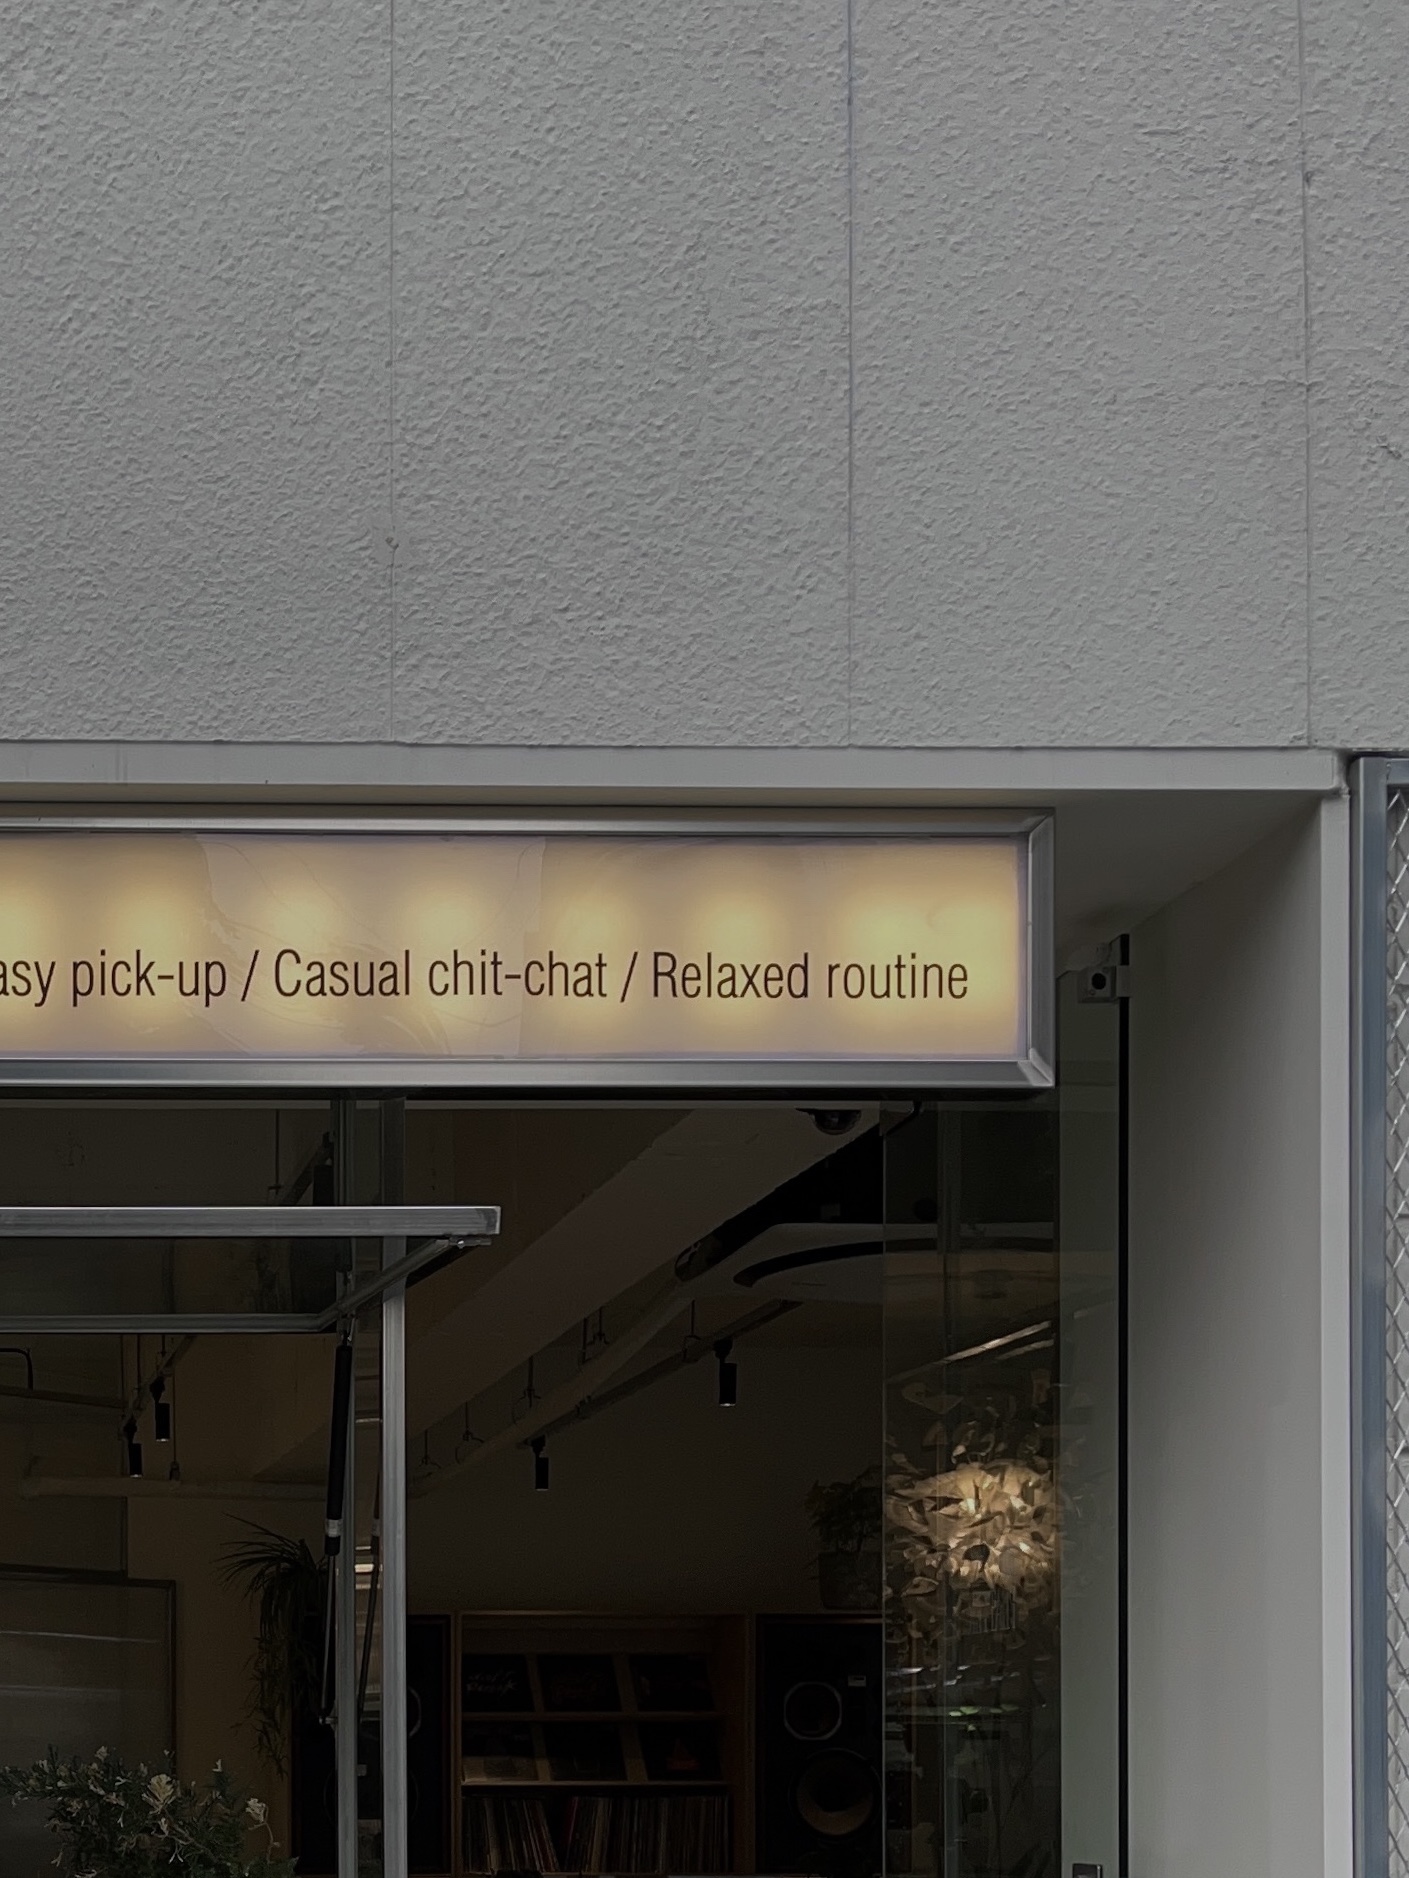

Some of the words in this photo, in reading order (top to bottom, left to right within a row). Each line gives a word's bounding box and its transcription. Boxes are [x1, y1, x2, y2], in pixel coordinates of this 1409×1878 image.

[73, 949, 226, 1008] pick-up
[241, 950, 260, 1002] /
[275, 949, 410, 997] Casual
[429, 949, 607, 997] chit-chat
[620, 951, 638, 1003] /
[653, 952, 808, 999] Relaxed
[828, 953, 967, 999] routine
